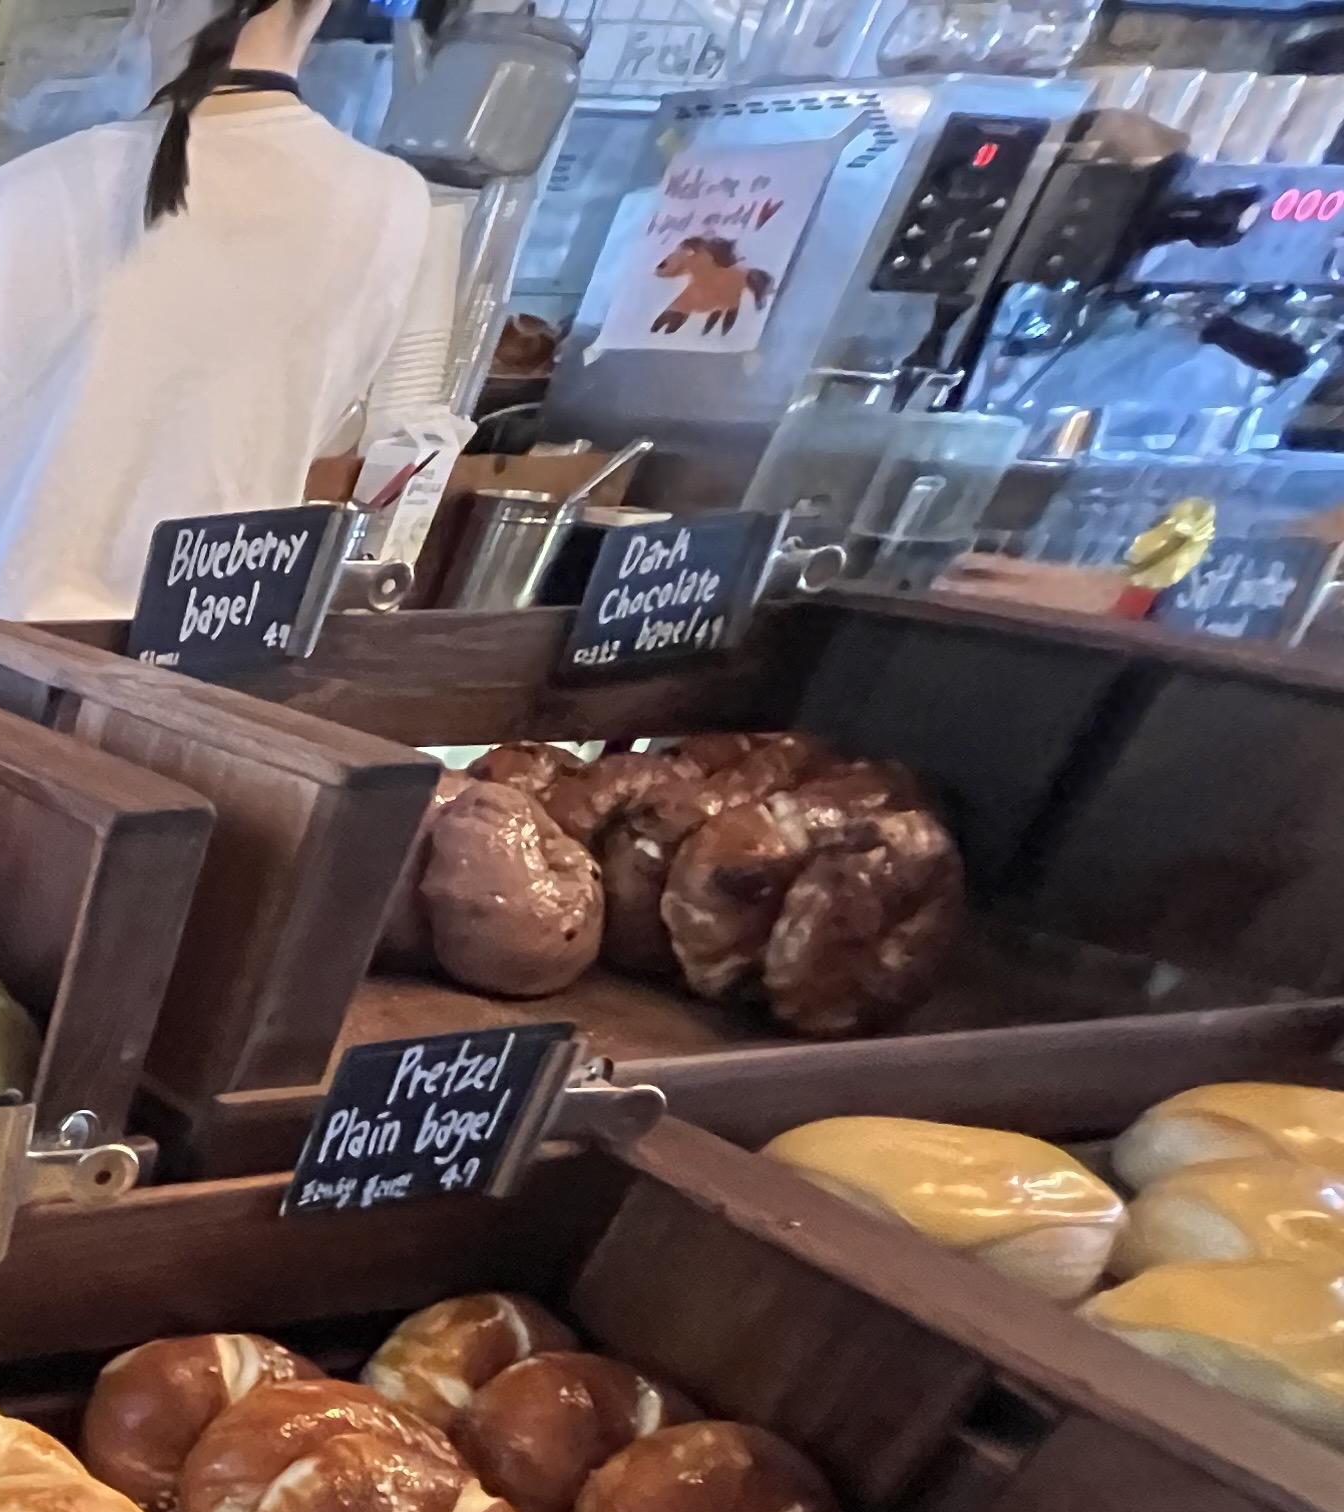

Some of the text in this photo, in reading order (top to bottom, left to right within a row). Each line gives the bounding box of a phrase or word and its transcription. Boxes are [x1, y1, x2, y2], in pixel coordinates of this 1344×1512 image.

[167, 524, 309, 587] Blueberry
[618, 527, 691, 580] Dark
[178, 580, 261, 643] bagel
[598, 567, 721, 625] Chocolate
[634, 606, 702, 651] bagel
[386, 1032, 516, 1105] Pretzel
[317, 1088, 511, 1165] Plain bagel
